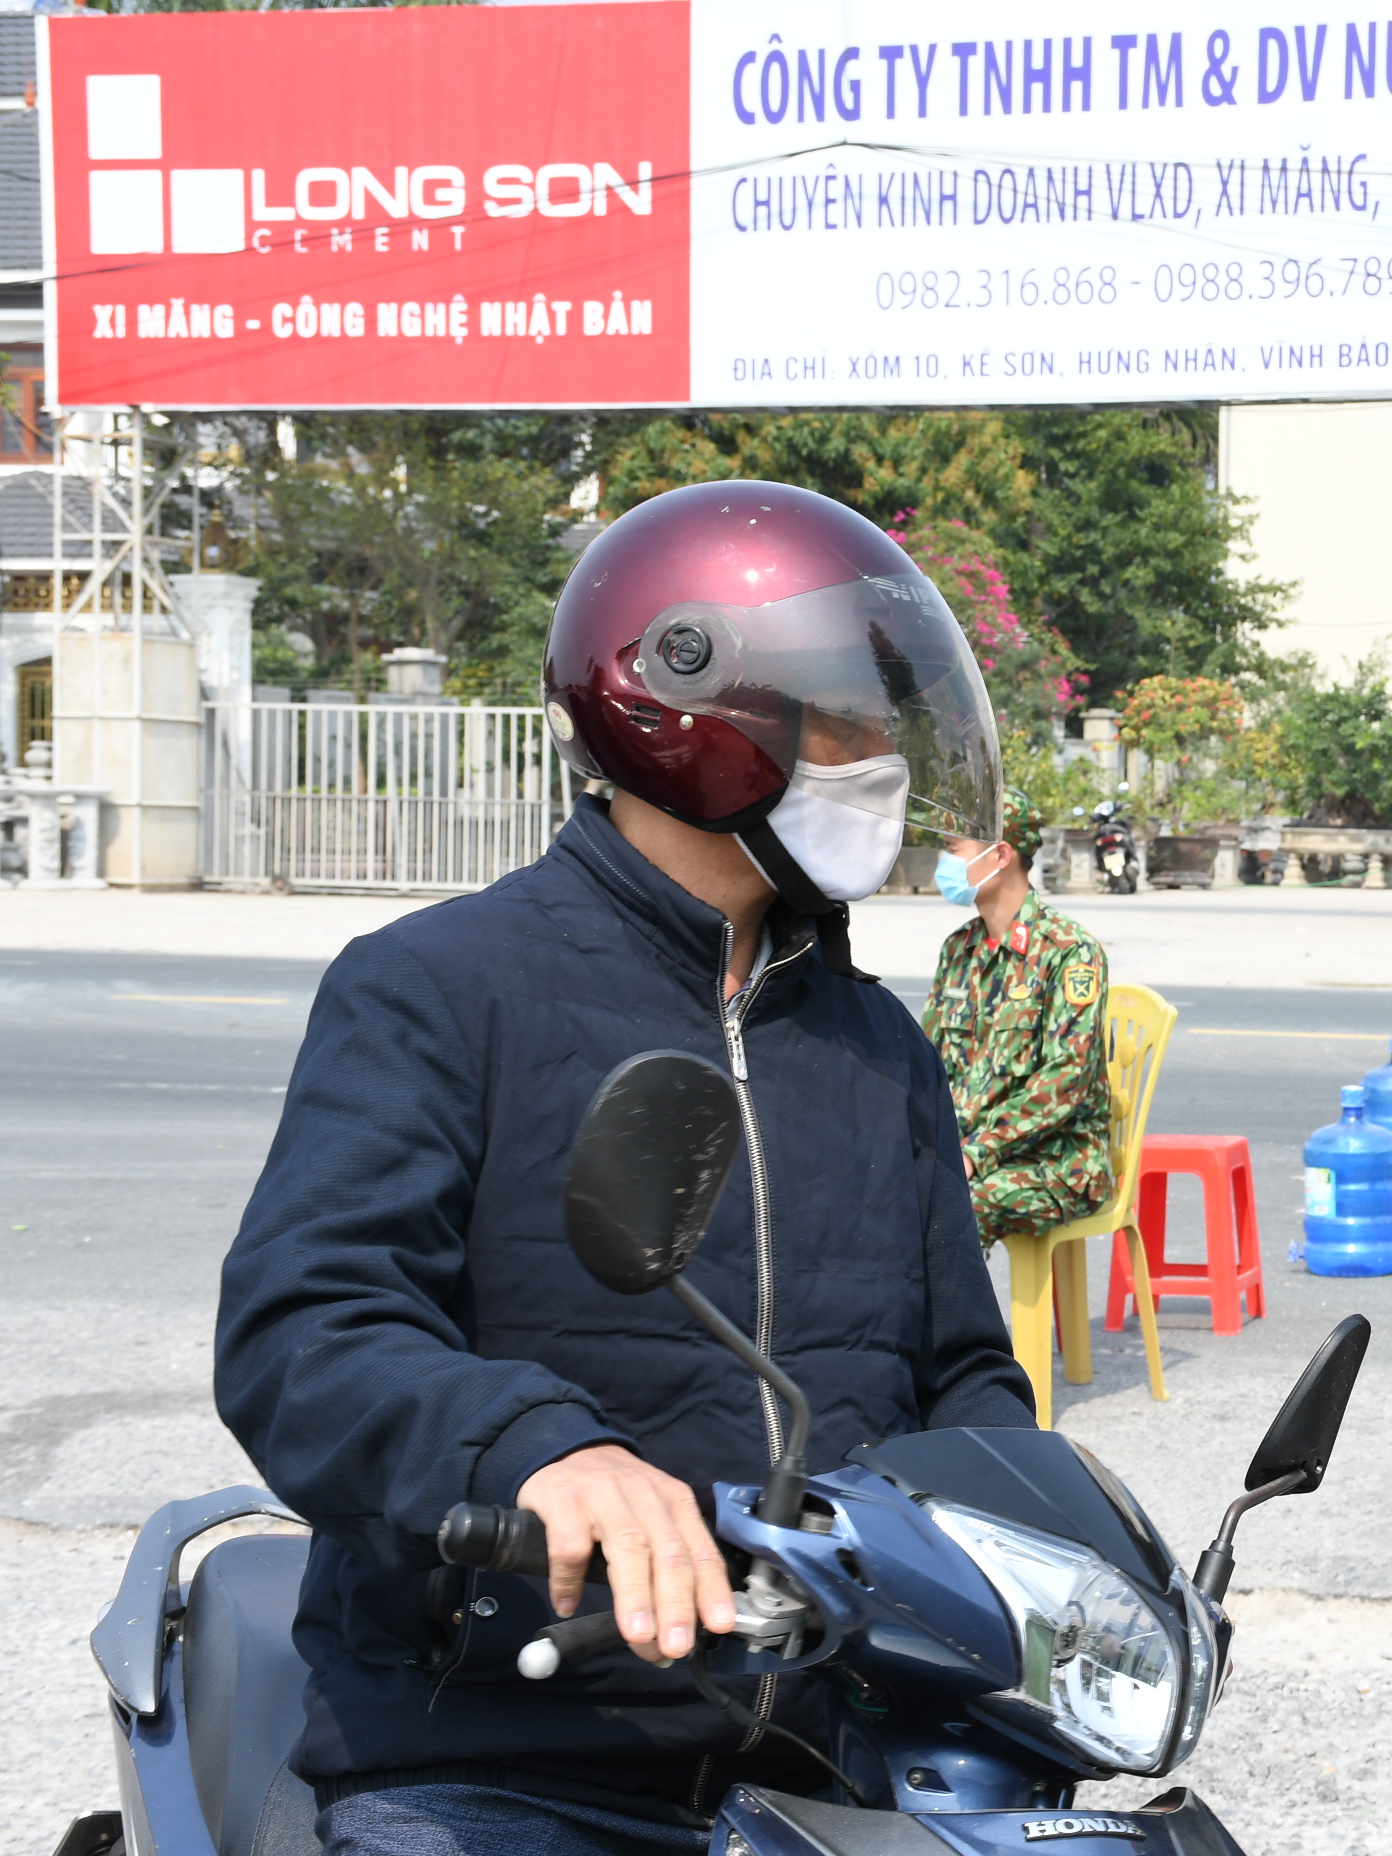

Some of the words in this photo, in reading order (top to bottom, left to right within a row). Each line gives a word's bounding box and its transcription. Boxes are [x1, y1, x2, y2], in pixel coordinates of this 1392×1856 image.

[732, 32, 862, 126] CÔNG
[878, 42, 938, 120] TY
[951, 35, 1093, 117] TNHH
[1110, 31, 1184, 111] TM
[1201, 28, 1240, 107] &
[1257, 23, 1329, 105] DV
[250, 164, 467, 222] LONG
[482, 160, 653, 219] SON
[732, 163, 863, 232] CHUYÊN
[877, 172, 958, 226] KINH
[972, 165, 1093, 225] DOANH
[1106, 162, 1202, 228] VLXD,
[1216, 159, 1246, 215] XI
[1261, 144, 1379, 220] MĂNG,
[876, 265, 1117, 310] 0982.316.868
[92, 303, 127, 339] XI
[137, 297, 235, 339] MĂNG
[271, 294, 366, 339] CÔNG
[376, 293, 469, 345] NGHỆ
[479, 292, 573, 345] NHẬT
[582, 290, 653, 337] BẢN
[1259, 339, 1325, 370] VĨNH
[1024, 1817, 1146, 1839] HONDA
